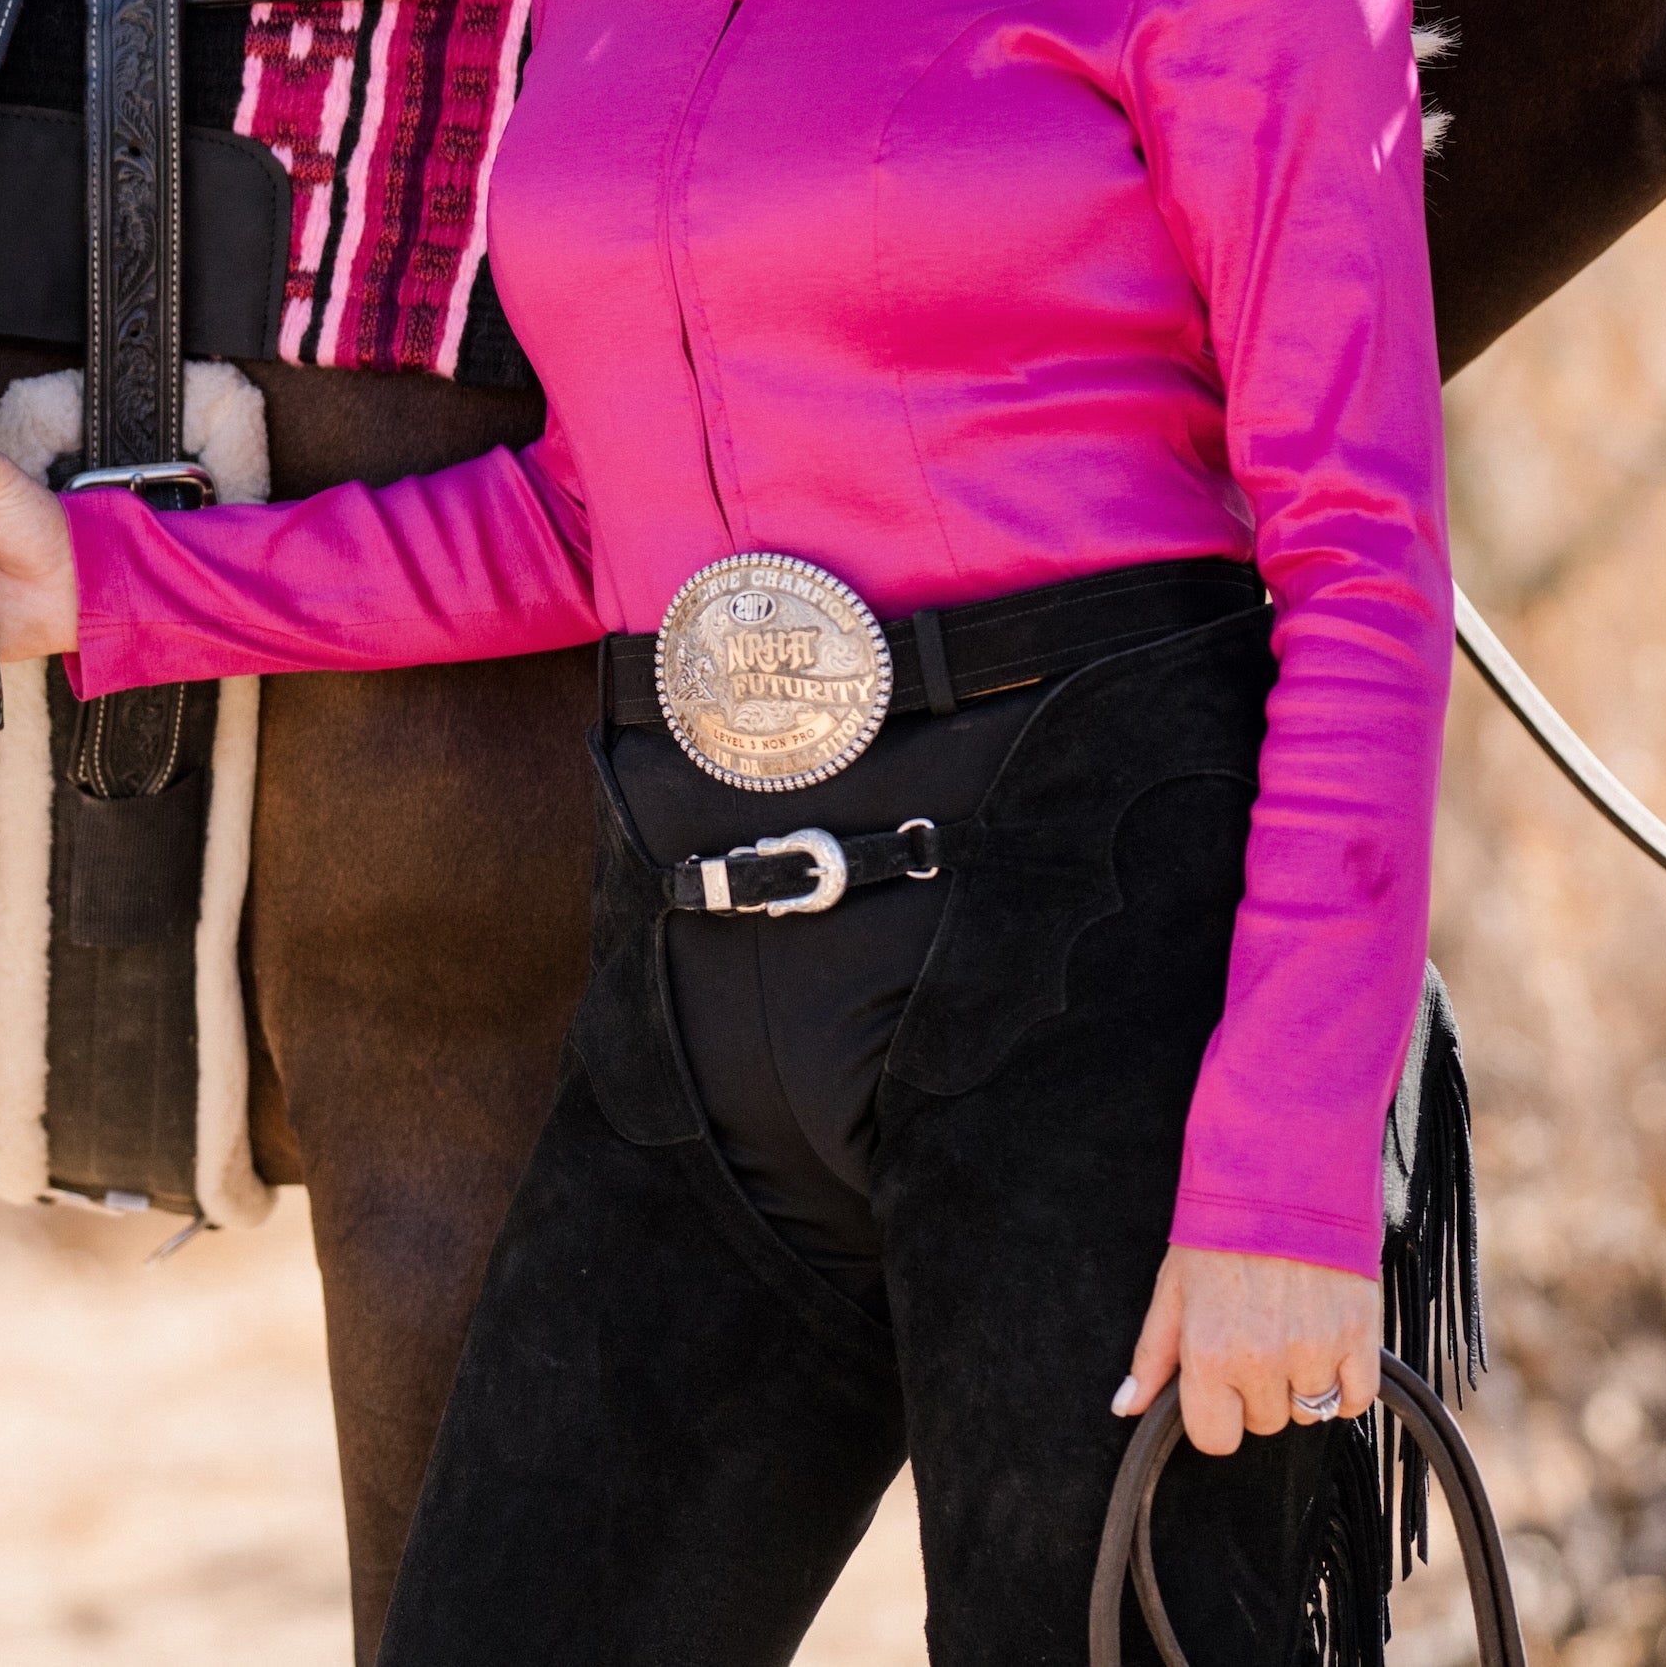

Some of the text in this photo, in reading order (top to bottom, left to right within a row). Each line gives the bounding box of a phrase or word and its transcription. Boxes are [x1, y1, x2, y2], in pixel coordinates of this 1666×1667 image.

[673, 569, 857, 633] ERVE CHAMPION
[735, 594, 770, 621] 2017
[724, 629, 818, 674] NRHA
[730, 672, 876, 703] FUTURITY
[713, 729, 745, 749] LEVEL
[761, 738, 787, 751] NON
[792, 728, 815, 745] PRO
